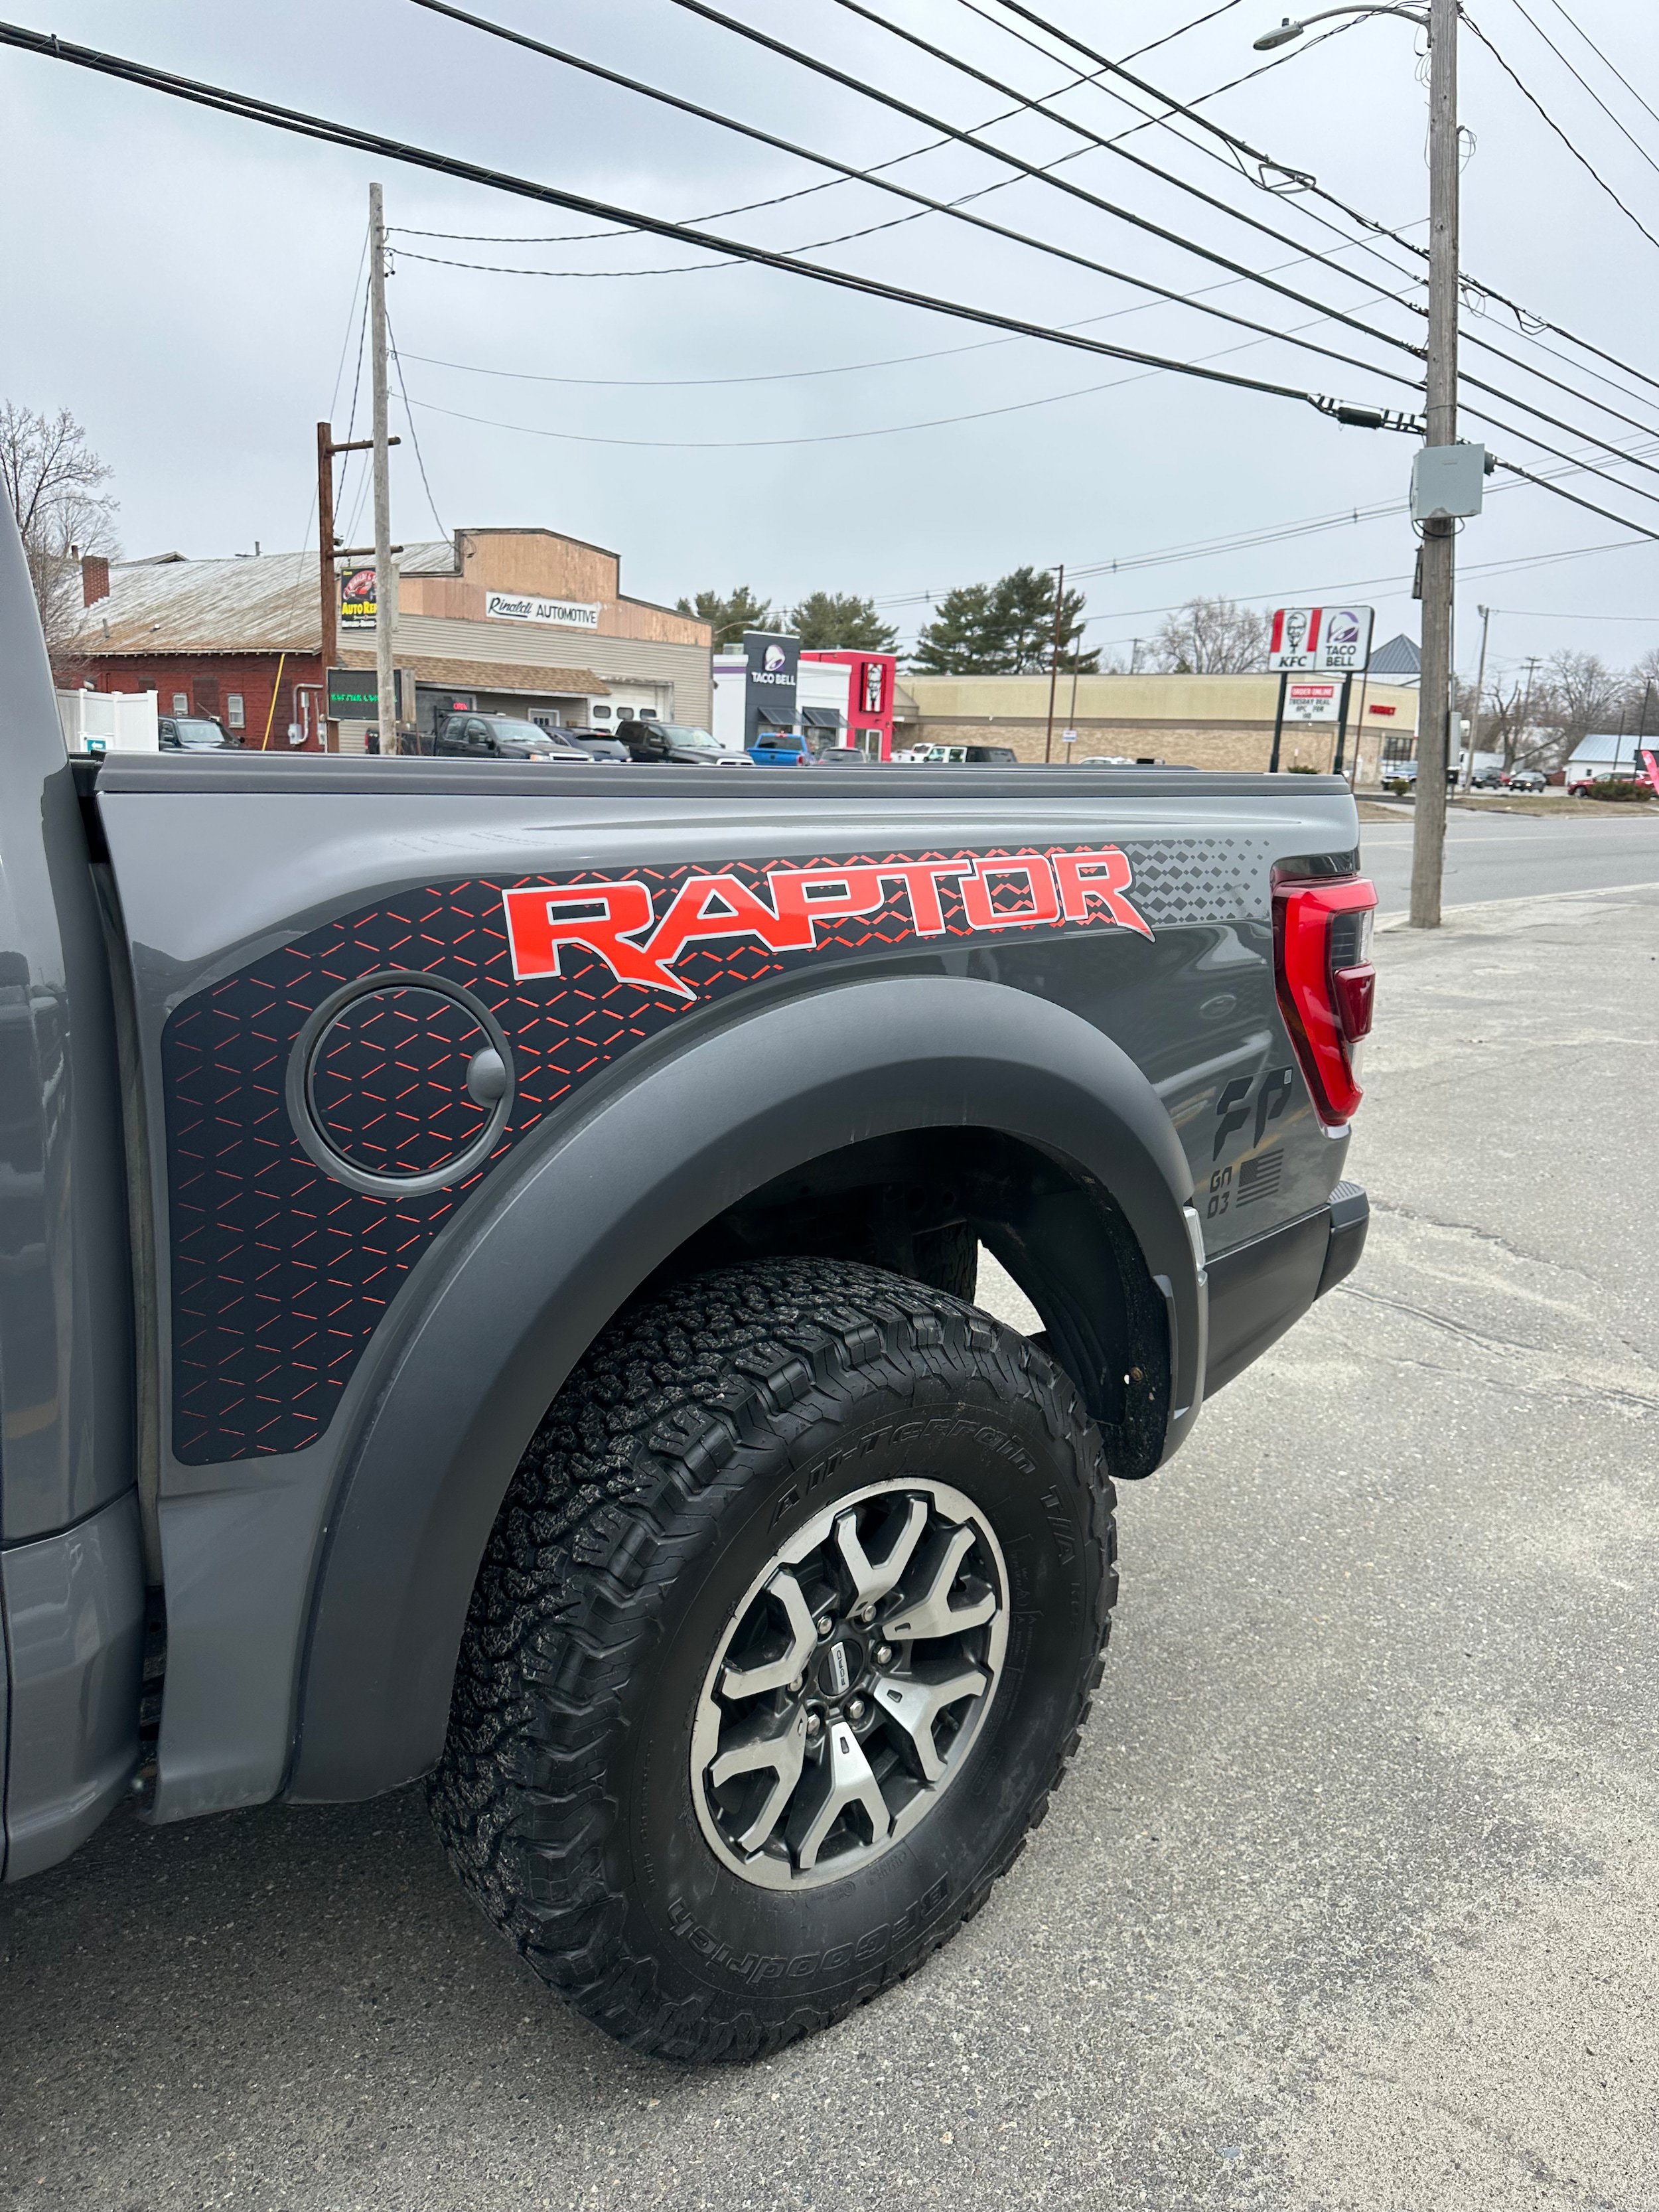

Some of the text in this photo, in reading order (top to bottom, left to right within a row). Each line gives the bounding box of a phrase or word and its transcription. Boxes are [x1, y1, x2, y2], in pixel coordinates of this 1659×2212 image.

[342, 602, 363, 615] AUTO
[488, 597, 597, 624] Rinaldi AUTOMOTIVE
[1326, 645, 1356, 655] TACO
[1279, 656, 1307, 667] KFC
[1326, 657, 1354, 666] BELL
[751, 672, 796, 686] TACO BELL
[502, 849, 1155, 1000] RAPTOR
[837, 1650, 845, 1686] FORD
[668, 1871, 949, 1984] BFGoodrich
